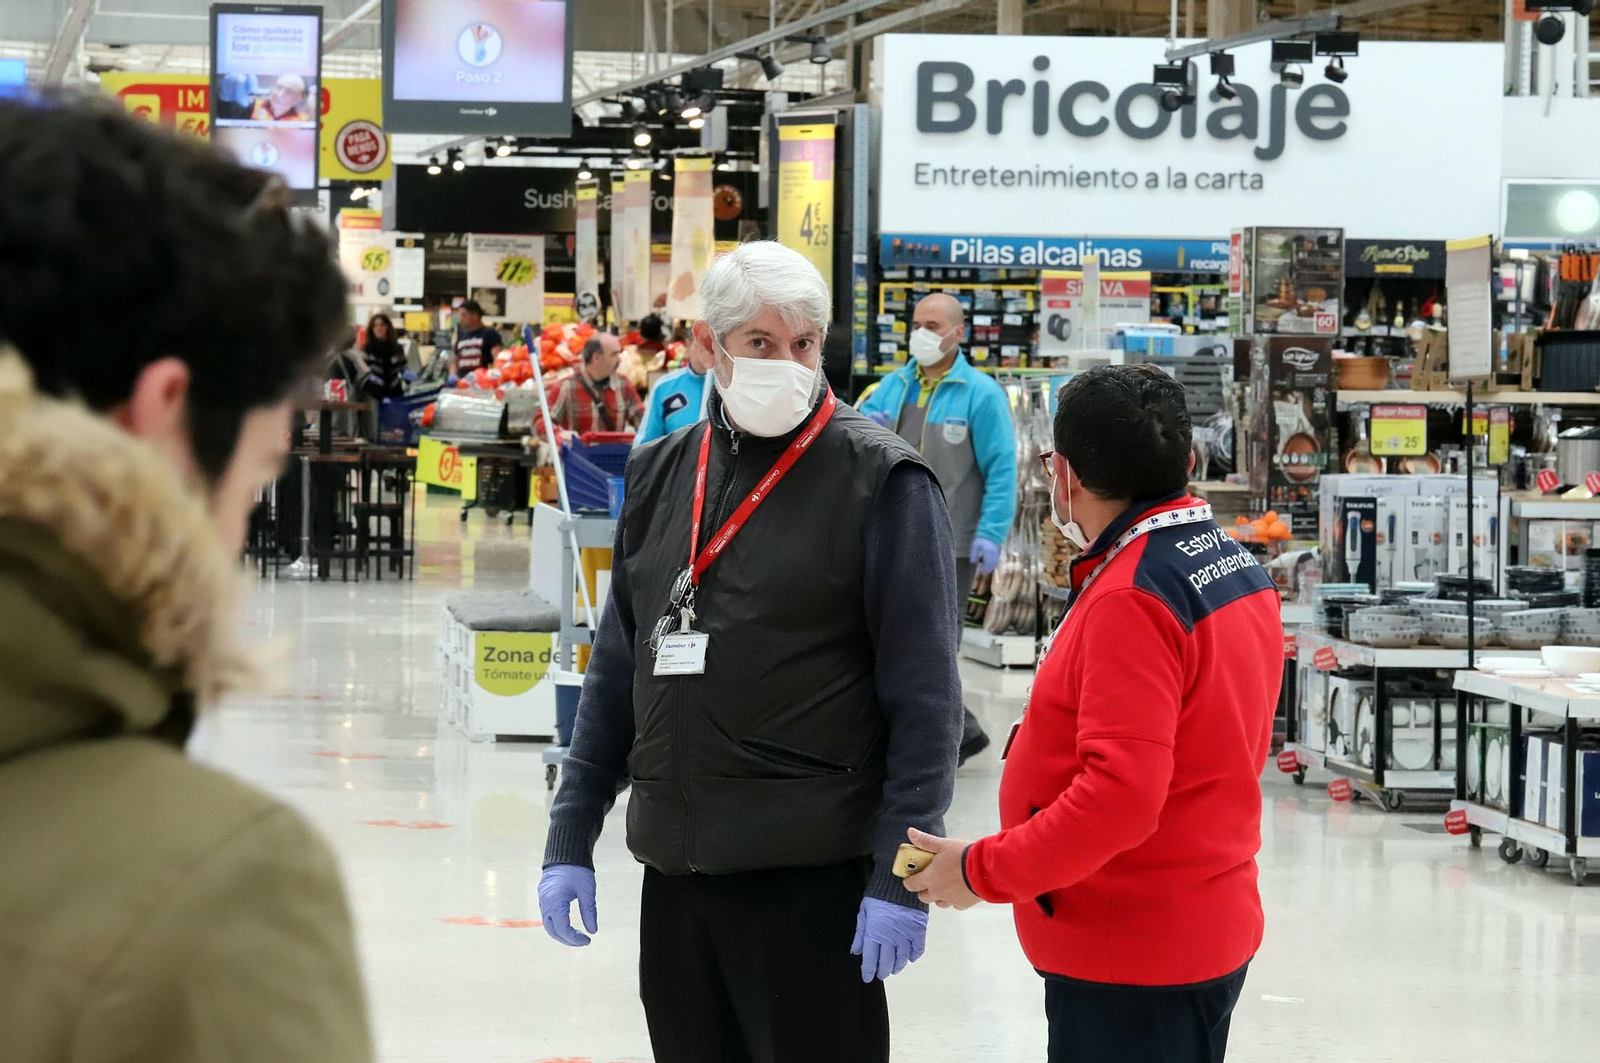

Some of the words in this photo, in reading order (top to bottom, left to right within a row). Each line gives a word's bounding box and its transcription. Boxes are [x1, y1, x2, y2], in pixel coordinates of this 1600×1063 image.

[232, 40, 250, 52] los
[456, 70, 491, 82] Paso
[492, 71, 501, 83] 2
[178, 89, 205, 108] IM
[916, 55, 1351, 161] Bricolaje
[914, 162, 1139, 189] Entretenimiento
[1145, 171, 1159, 189] a
[1166, 166, 1188, 190] la
[1195, 169, 1265, 191] carta
[524, 188, 578, 208] Sush
[800, 203, 813, 246] 4
[814, 223, 830, 246] 25
[950, 238, 1015, 264] Pilas
[1020, 240, 1142, 268] alcalinas
[1190, 259, 1230, 273] recarg
[1066, 280, 1083, 295] Si
[1100, 281, 1126, 296] VA
[759, 469, 780, 492] Carrefour
[1174, 527, 1221, 557] Estoy
[1187, 564, 1221, 595] para
[483, 646, 534, 663] Zona
[539, 647, 561, 664] de
[483, 668, 532, 681] Tómate
[534, 672, 549, 680] un
